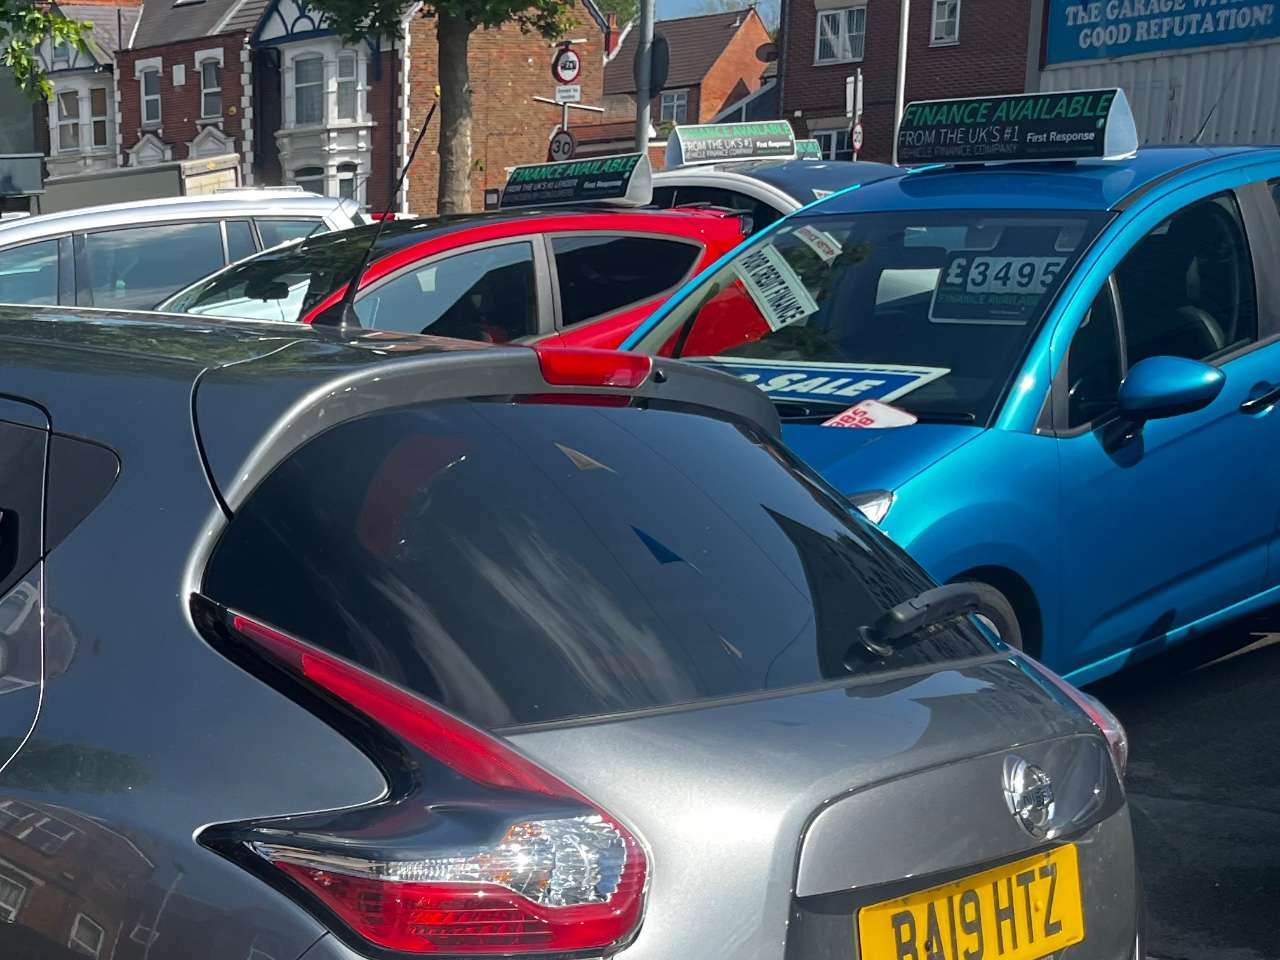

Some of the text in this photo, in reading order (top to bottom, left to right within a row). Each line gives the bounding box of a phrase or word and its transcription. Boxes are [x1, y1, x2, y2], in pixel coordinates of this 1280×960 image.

[1065, 4, 1101, 26] THE
[1078, 4, 1275, 49] GOOD REPUTATION!
[901, 94, 1114, 128] FINANCE AVAILABLE
[553, 140, 571, 156] 30
[683, 140, 707, 152] FROM
[707, 139, 723, 150] THE
[898, 125, 1020, 147] FROM THE UK'S #1
[1026, 131, 1095, 143] First Response
[511, 156, 639, 182] FINANCE AVAILABLE
[750, 264, 787, 294] CREDIT
[946, 257, 1063, 289] £3495
[764, 286, 806, 324] FINANCE
[762, 373, 886, 397] SALE
[992, 862, 1064, 957] HTZ
